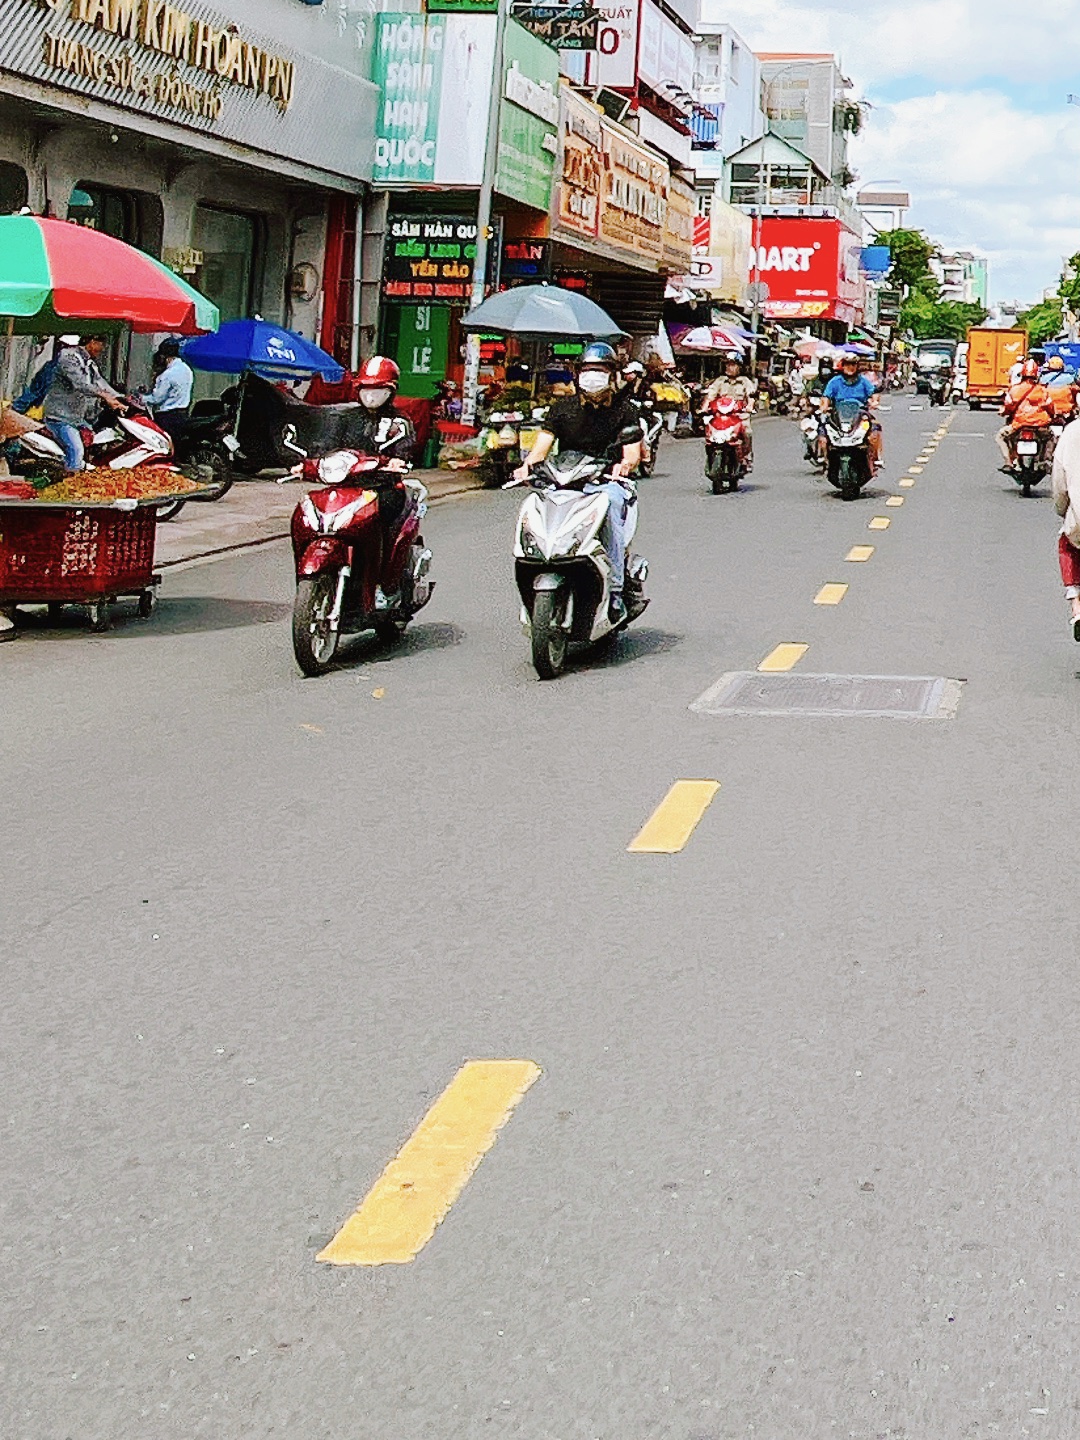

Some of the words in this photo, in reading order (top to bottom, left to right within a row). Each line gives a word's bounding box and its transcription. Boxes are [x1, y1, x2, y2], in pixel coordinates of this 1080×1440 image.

[42, 32, 107, 81] TRANG
[259, 50, 296, 114] PNJ
[392, 220, 420, 237] SÂM
[424, 221, 453, 238] HÀN
